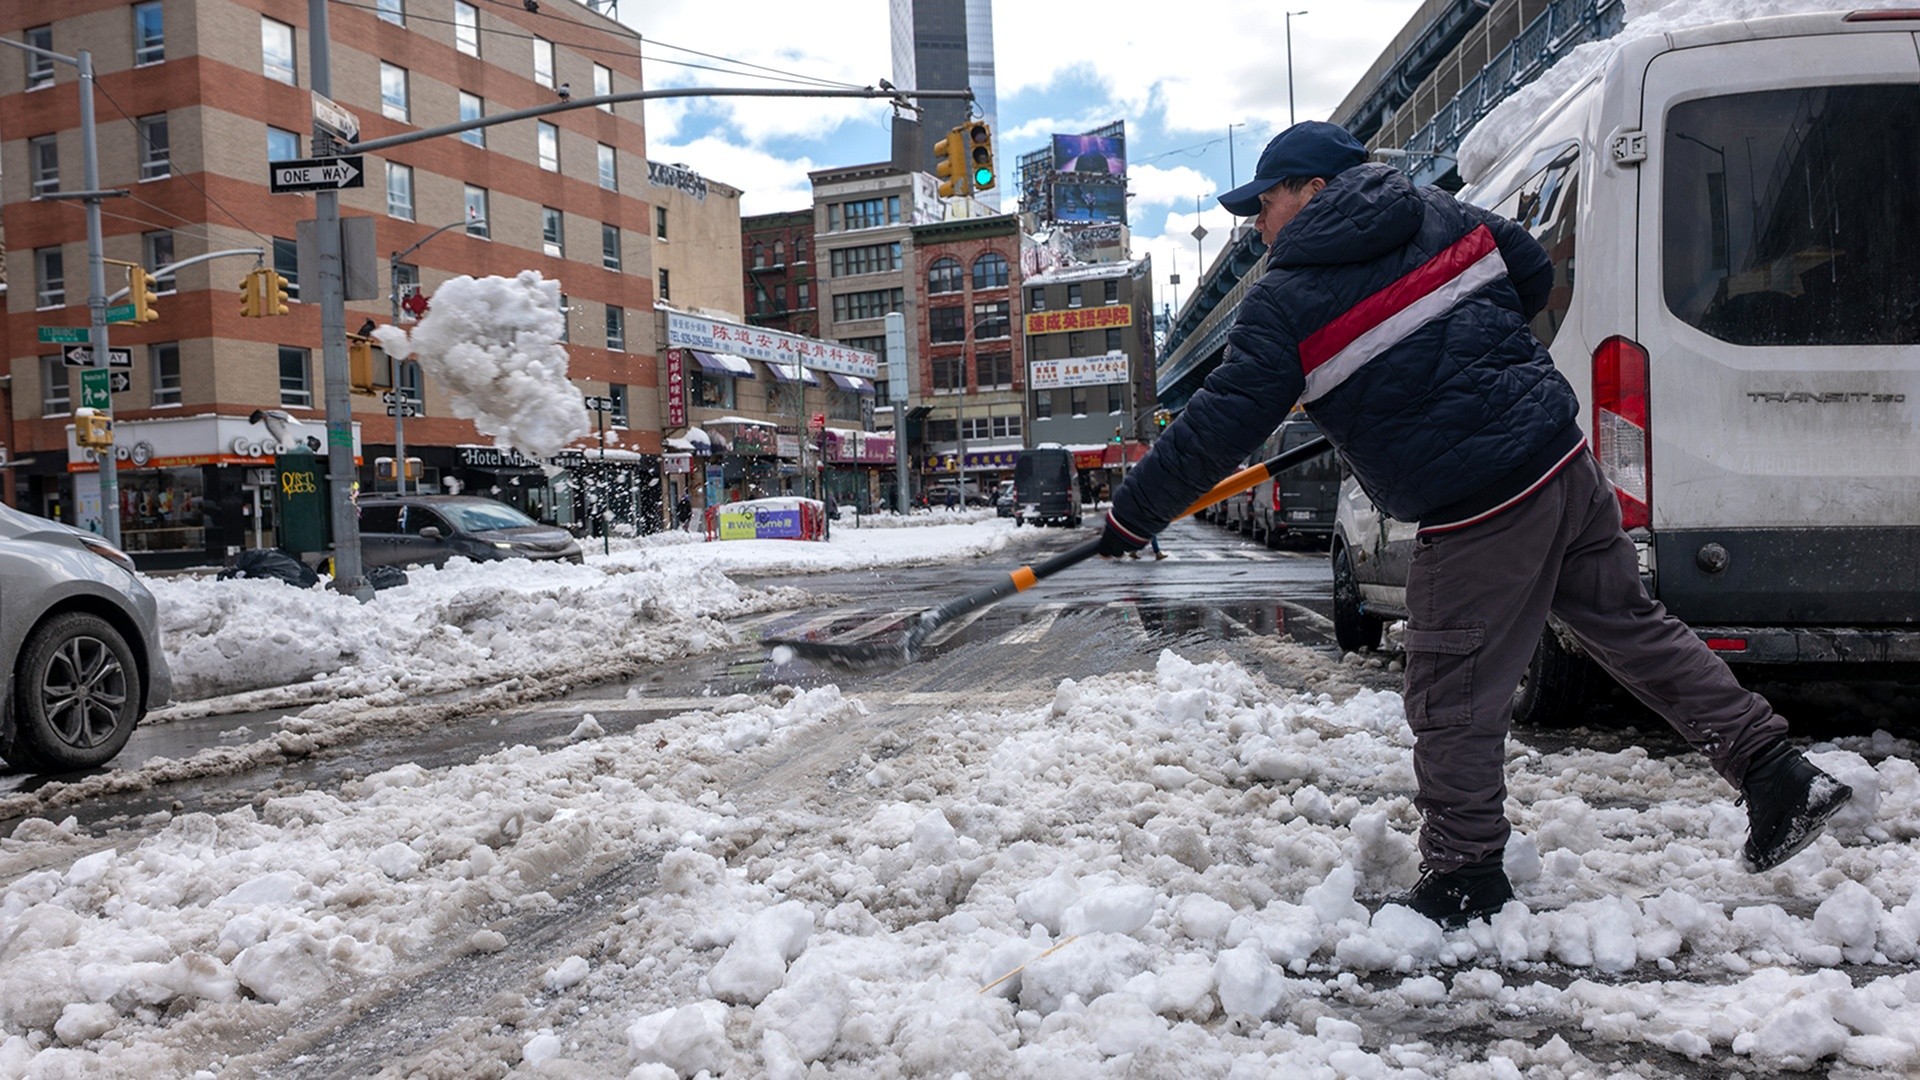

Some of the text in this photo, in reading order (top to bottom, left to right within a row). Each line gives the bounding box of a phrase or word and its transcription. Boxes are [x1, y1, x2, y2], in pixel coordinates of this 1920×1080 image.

[284, 167, 350, 183] ONE WAY
[1028, 306, 1130, 333] 速成英語學院
[110, 353, 124, 361] AY
[1747, 392, 1869, 403] TRANSIT
[233, 436, 287, 458] CoCo
[466, 449, 502, 465] Hotel
